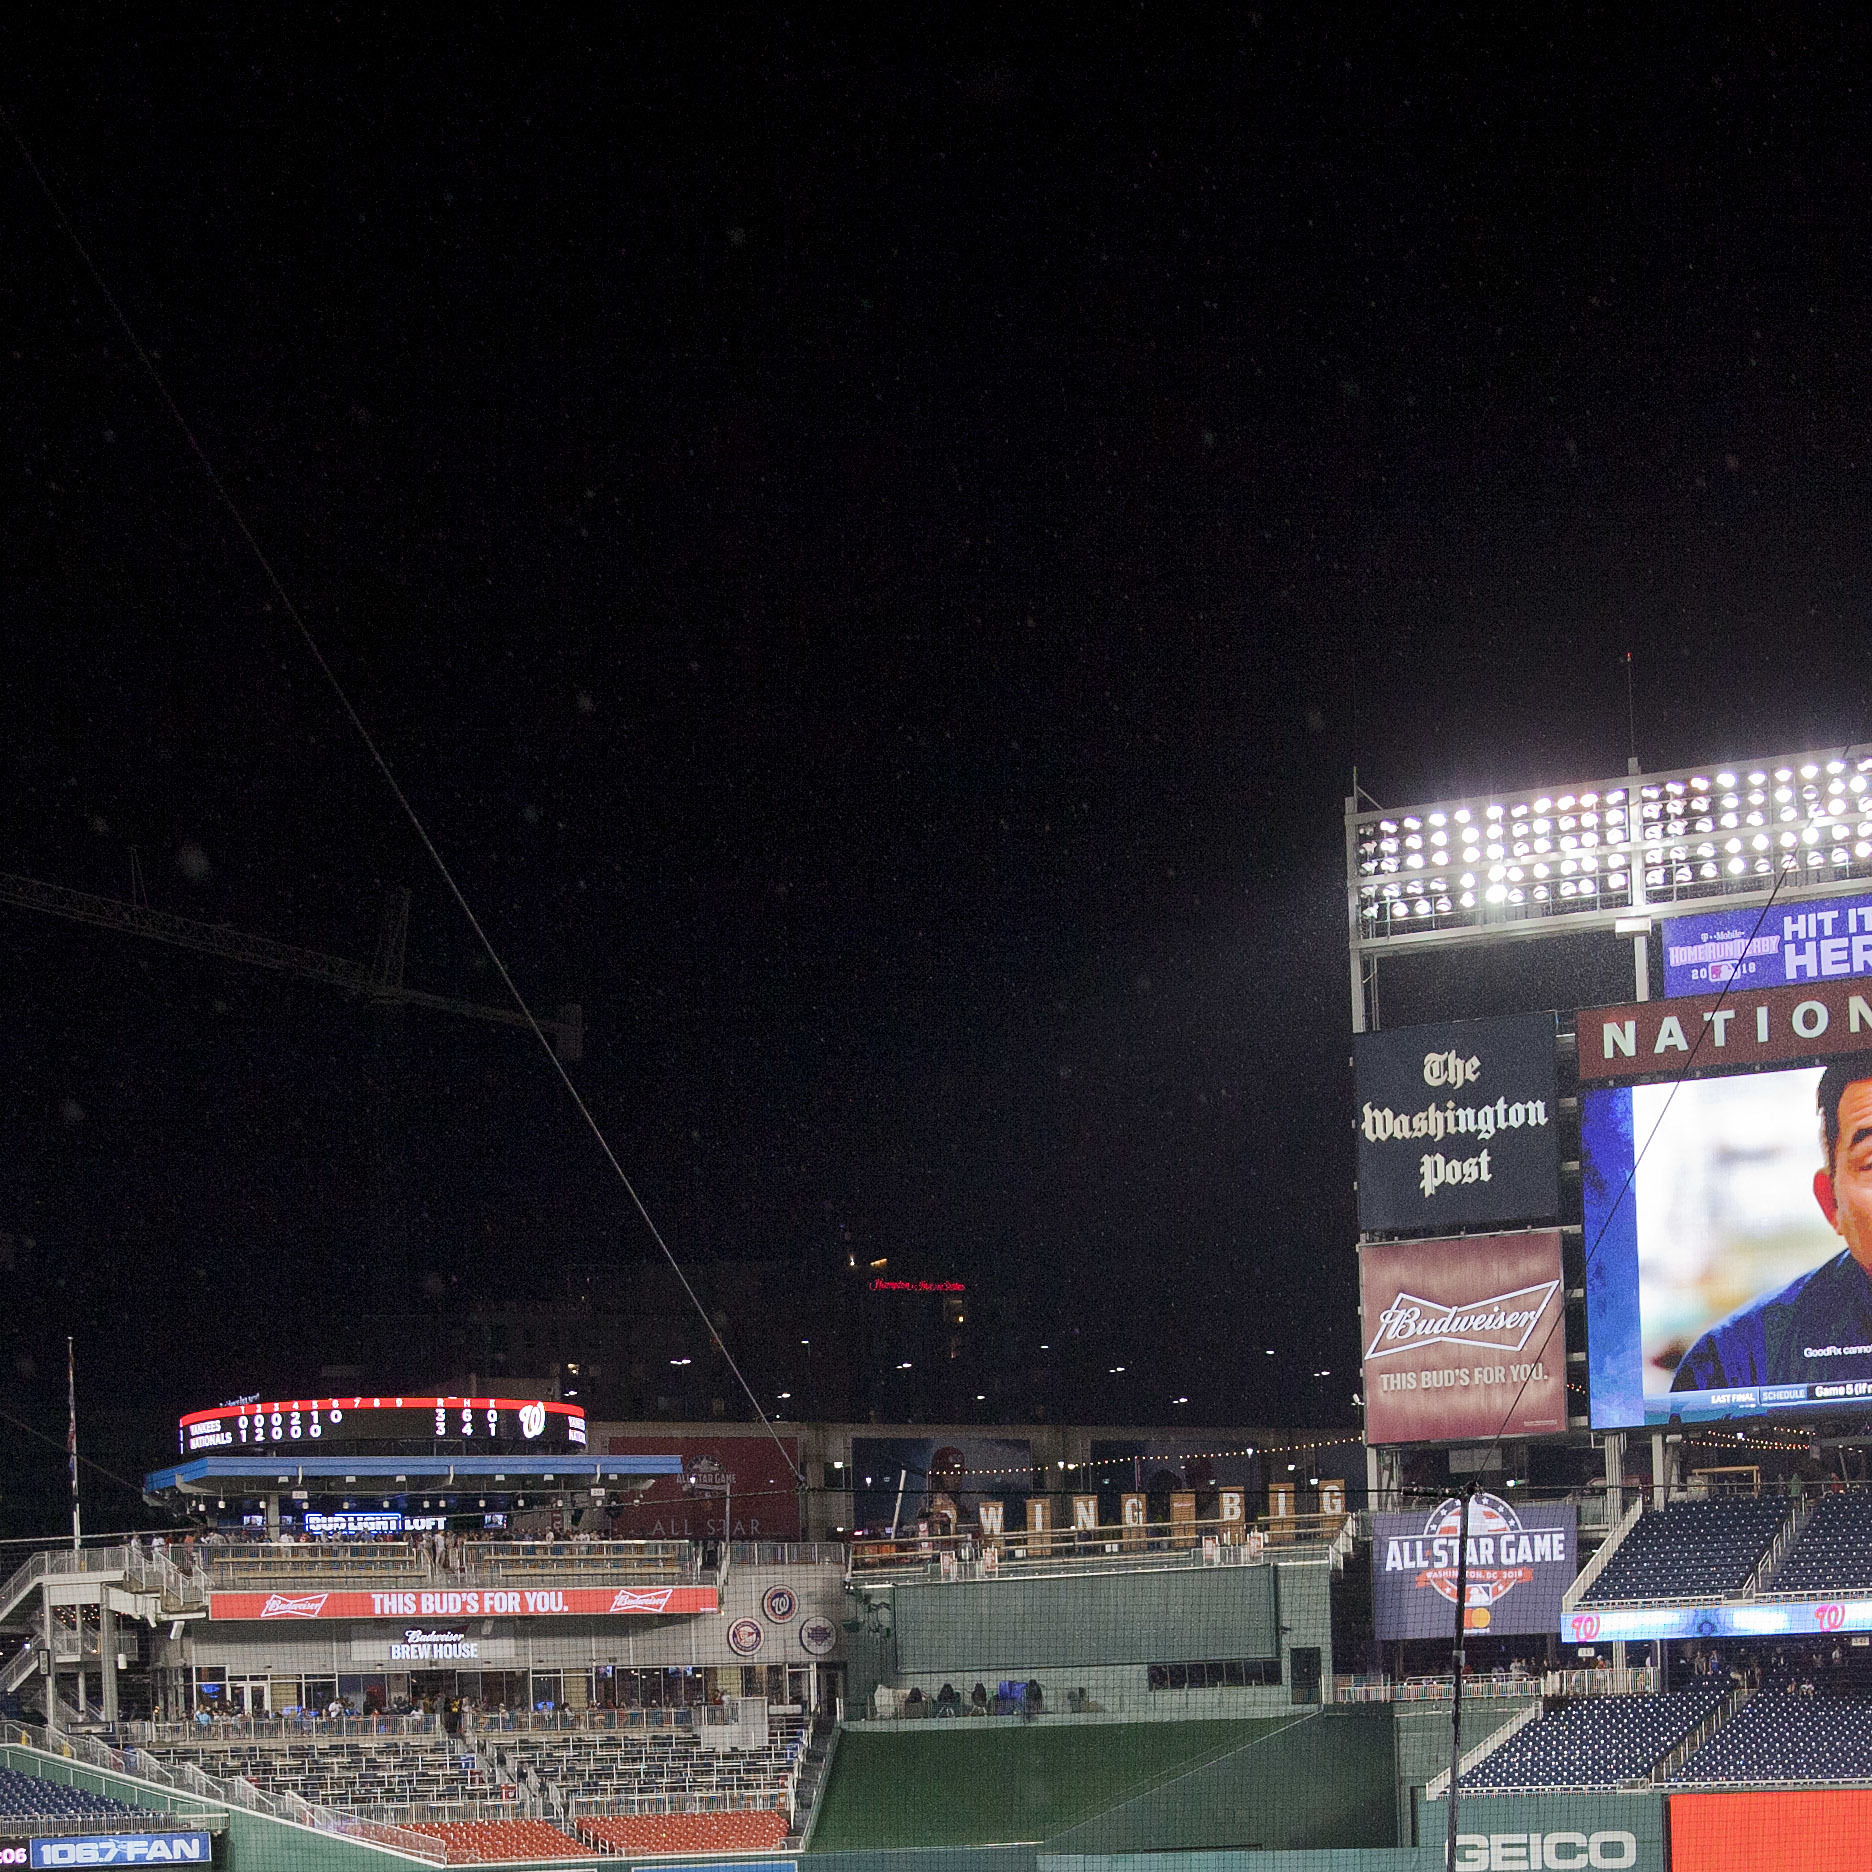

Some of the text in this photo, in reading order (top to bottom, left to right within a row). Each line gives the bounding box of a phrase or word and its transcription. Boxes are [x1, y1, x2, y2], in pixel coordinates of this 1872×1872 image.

[1783, 910, 1838, 940] HIT
[1669, 934, 1780, 967] HOME RUN DERBY
[1423, 1051, 1481, 1087] The
[1359, 1096, 1549, 1146] Washington
[1419, 1147, 1492, 1198] Post
[1379, 1305, 1539, 1341] Budweiser
[1380, 1362, 1549, 1392] THIS BUD'S FOR YOU.
[1815, 1384, 1845, 1398] Game
[1762, 1388, 1806, 1401] SCHEDULE
[238, 1415, 248, 1430] 0
[254, 1414, 265, 1428] 0
[271, 1412, 282, 1427] 0
[290, 1411, 301, 1426] 2
[330, 1409, 343, 1424] 0
[190, 1424, 321, 1450] NATIONALS 2 0 0 0
[309, 1516, 347, 1531] BUD
[347, 1516, 399, 1531] LIGHT
[1385, 1532, 1566, 1572] ALL STAR GAME
[372, 1590, 569, 1615] THIS BUD'S FOR YOU.
[391, 1642, 479, 1660] BREW HOUSE
[404, 1629, 464, 1645] Budweiser
[42, 1838, 201, 1866] 106.7 FAN
[1445, 1830, 1637, 1872] GEICO
